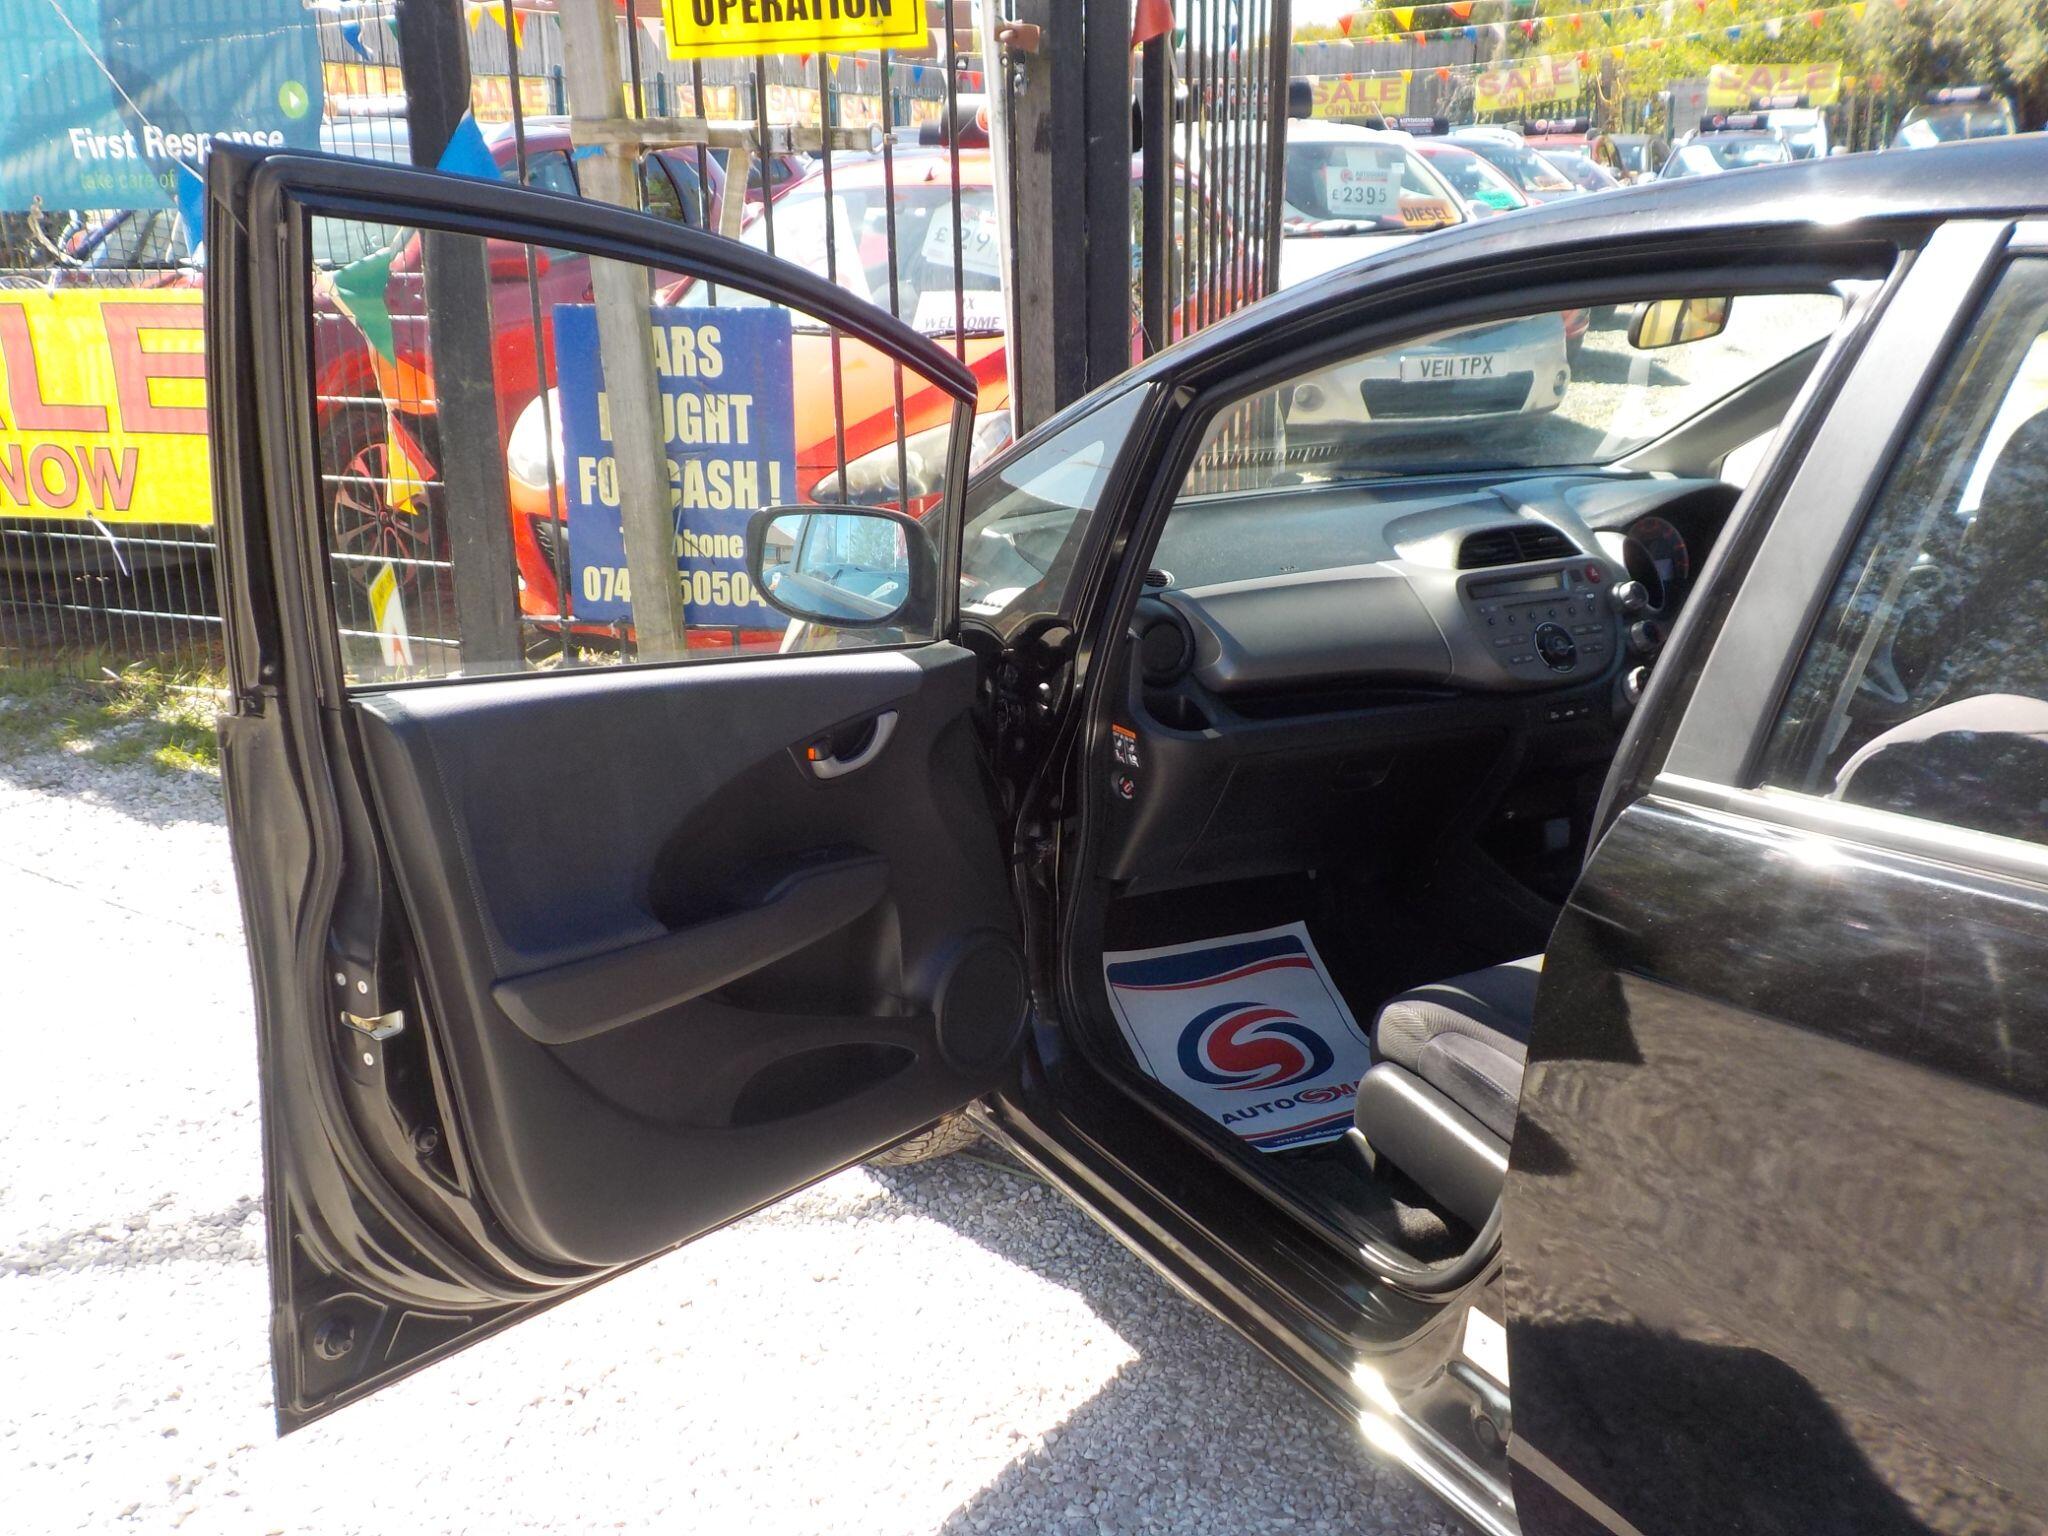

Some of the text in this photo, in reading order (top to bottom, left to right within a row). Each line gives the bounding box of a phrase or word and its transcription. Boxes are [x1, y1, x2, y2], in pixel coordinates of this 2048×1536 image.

[1478, 61, 1573, 96] SALE
[1312, 80, 1403, 104] SALE
[1325, 103, 1382, 116] ON NOW
[68, 127, 137, 160] First
[159, 170, 175, 188] of
[1402, 206, 1453, 221] DIESEL
[924, 316, 1000, 329] WELOME
[0, 303, 208, 435] LE
[1460, 356, 1494, 375] TPX
